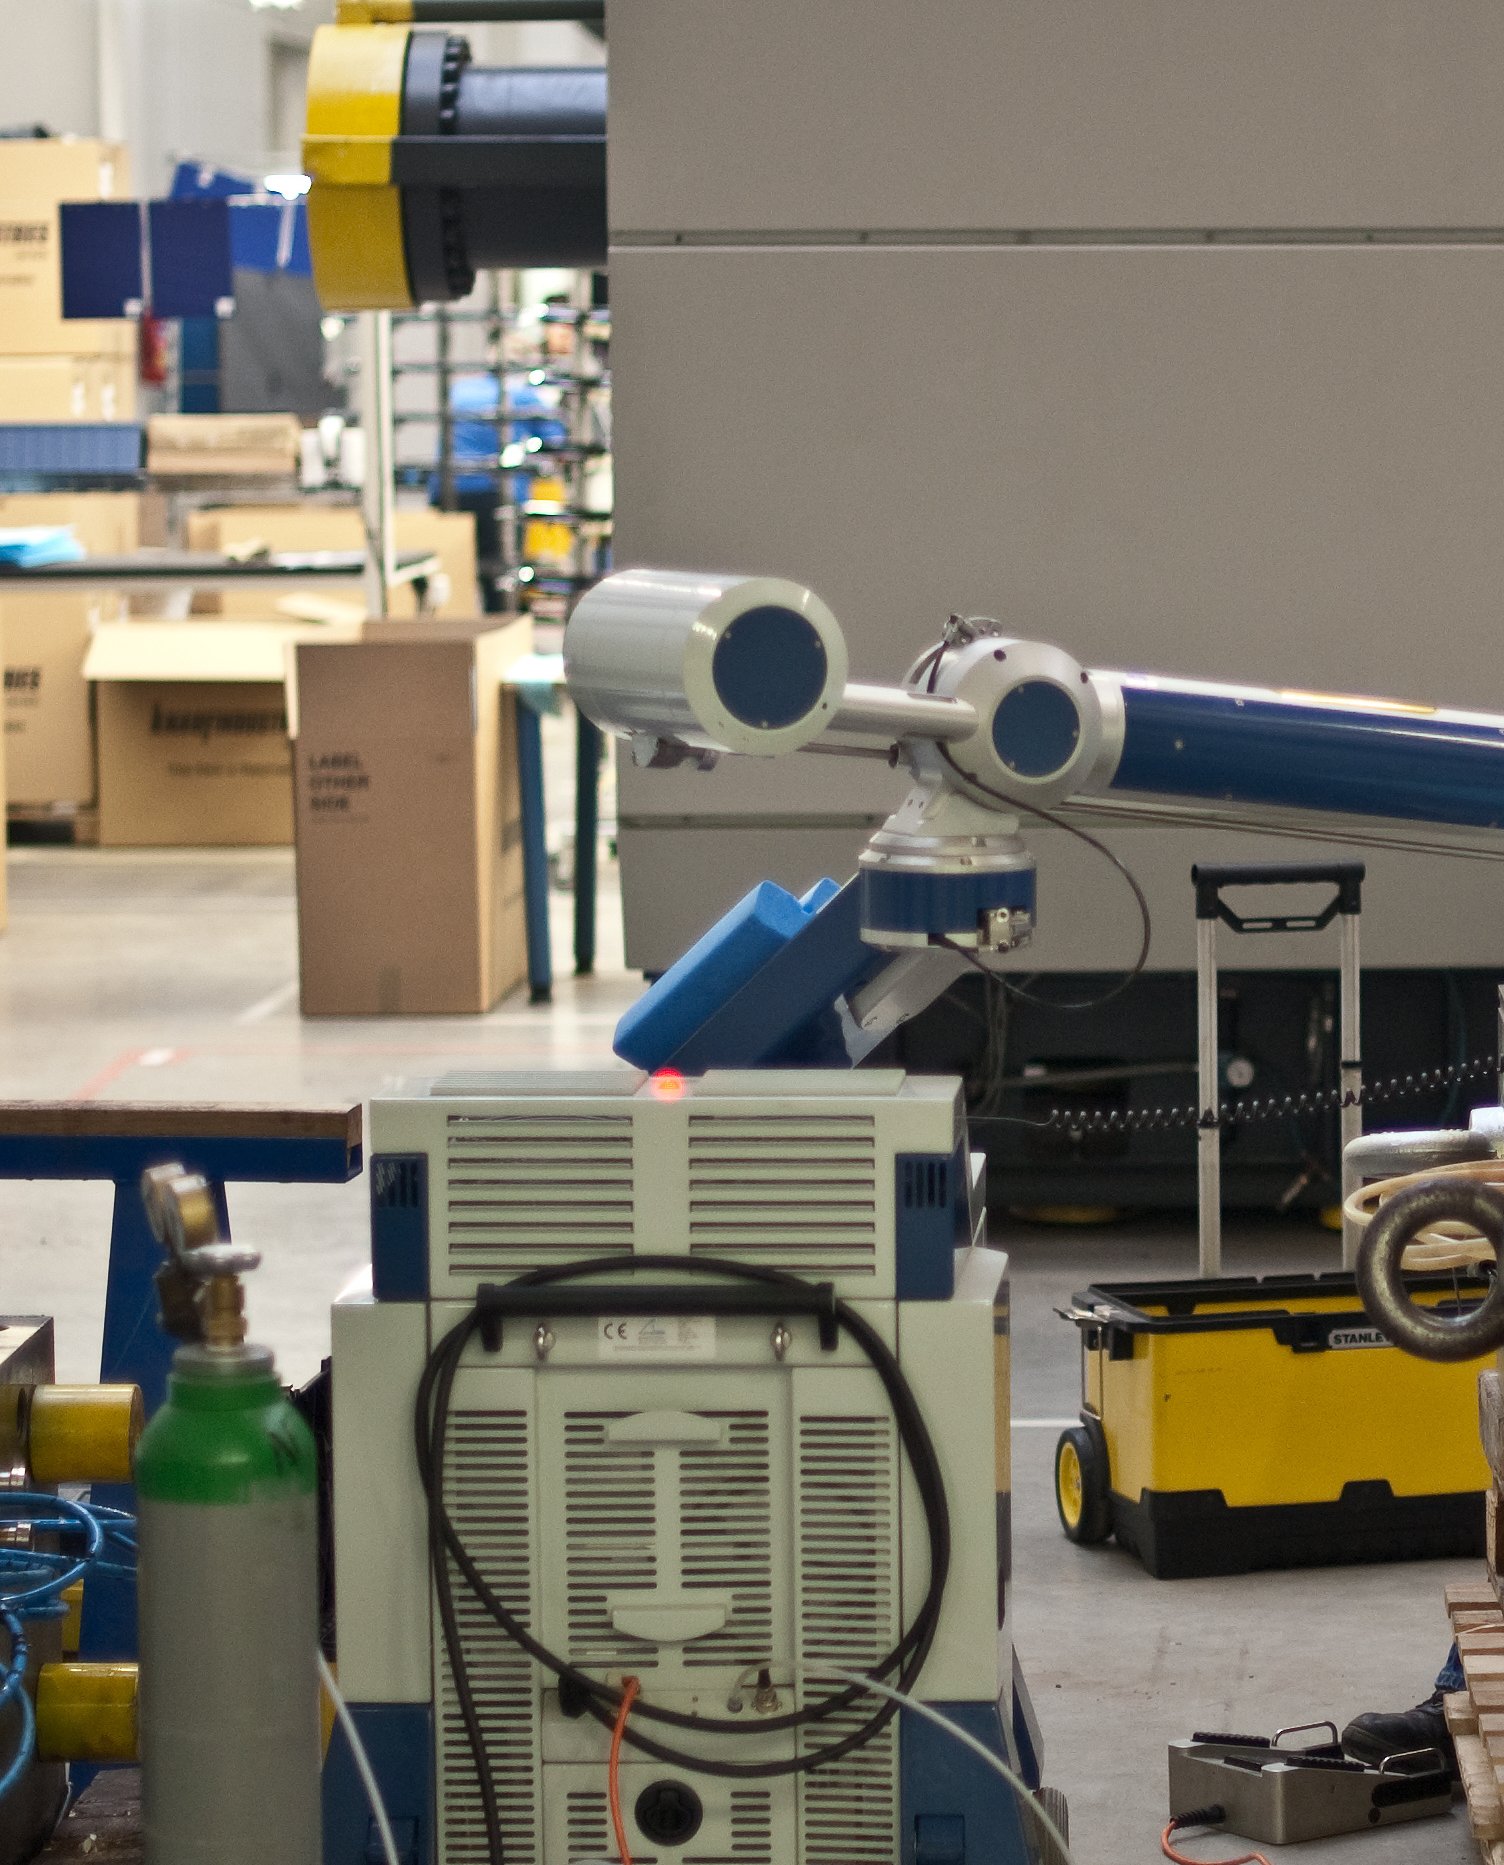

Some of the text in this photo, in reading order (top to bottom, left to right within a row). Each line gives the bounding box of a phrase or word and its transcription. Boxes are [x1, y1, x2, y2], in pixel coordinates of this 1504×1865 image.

[310, 752, 363, 770] LABEL
[310, 774, 370, 790] OTHER
[1333, 1331, 1384, 1345] STANLE
